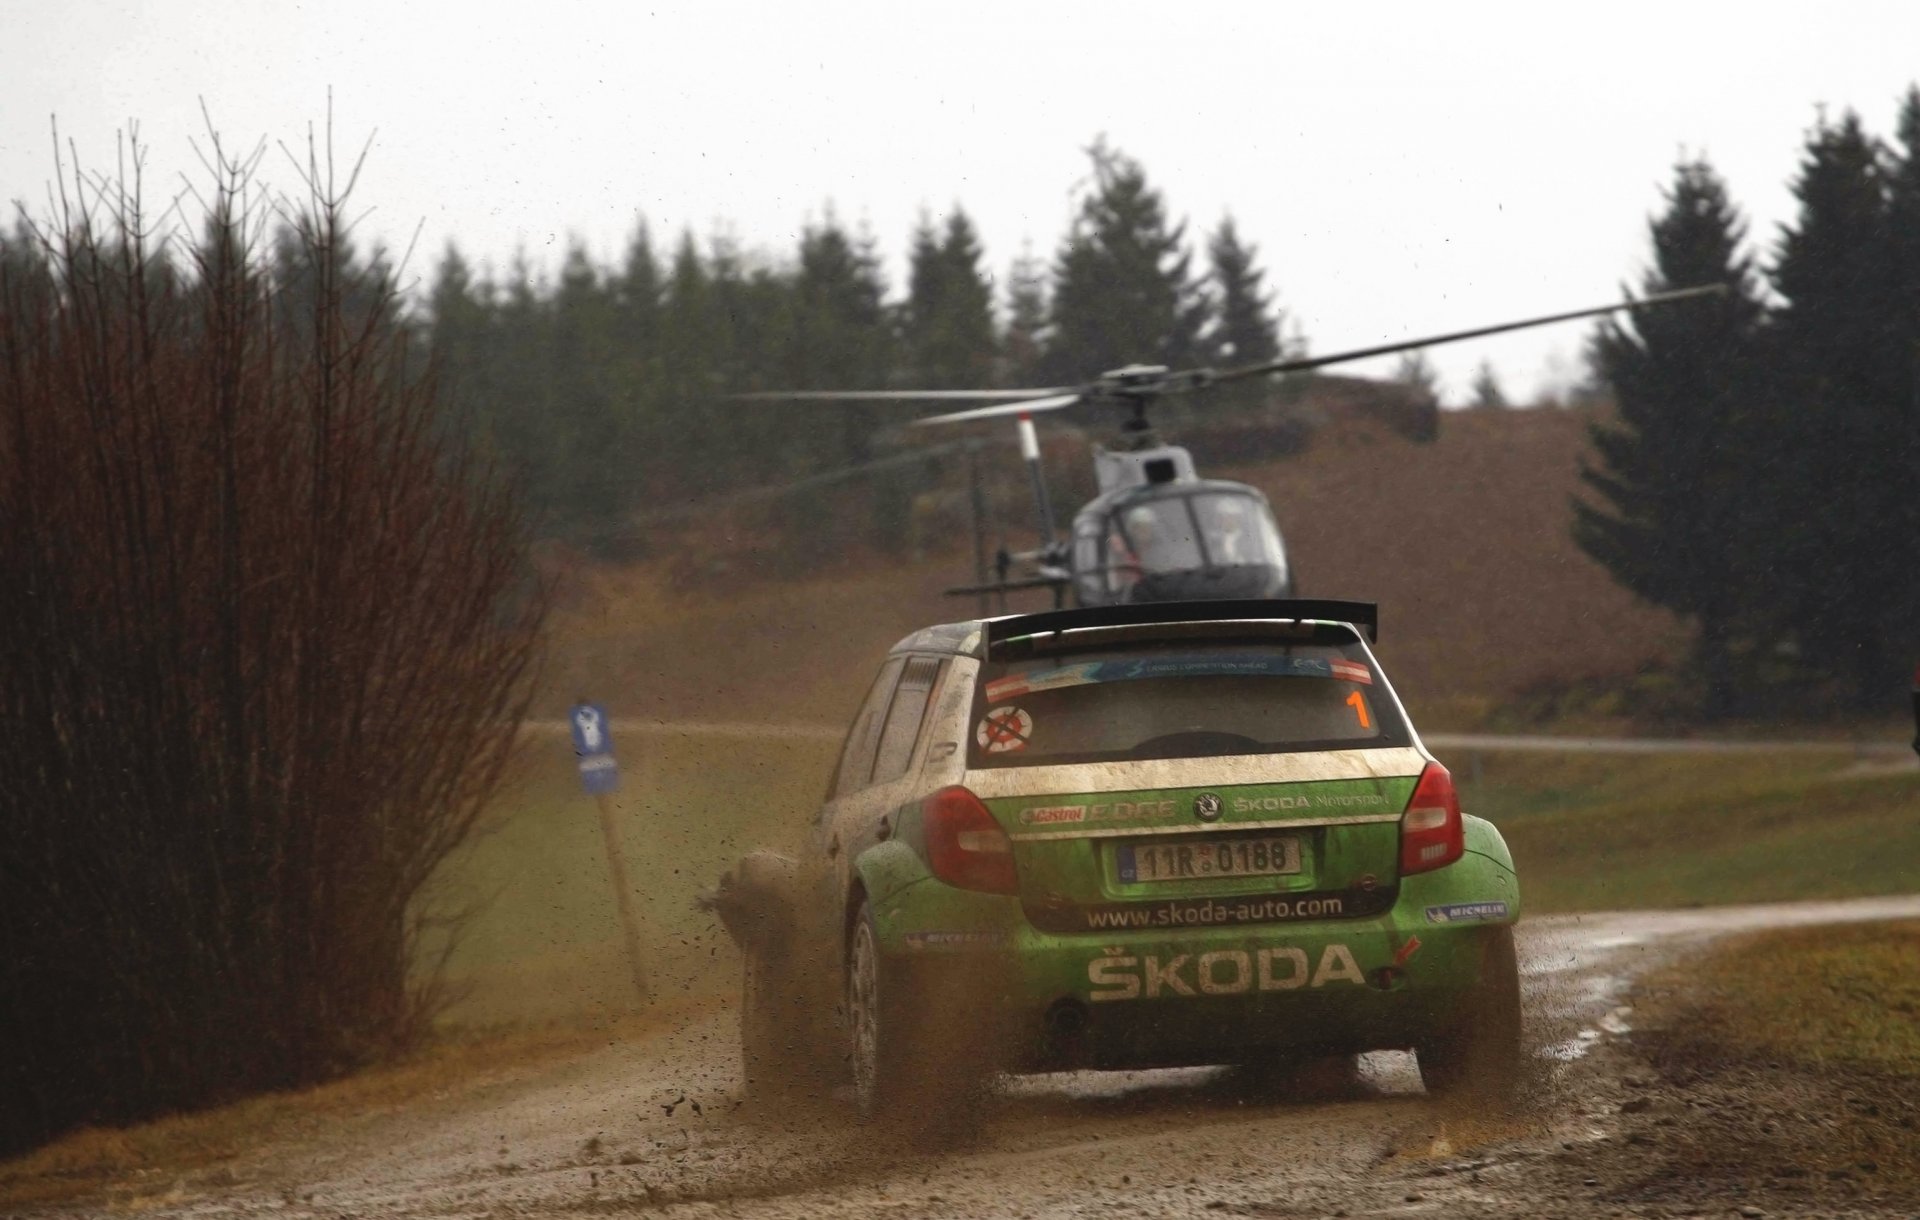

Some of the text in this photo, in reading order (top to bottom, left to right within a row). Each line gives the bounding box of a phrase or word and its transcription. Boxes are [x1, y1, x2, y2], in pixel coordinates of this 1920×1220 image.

[1346, 690, 1370, 729] 1
[1035, 800, 1177, 823] Castrol EDGE
[1143, 841, 1287, 877] 11R 0188
[1088, 898, 1343, 928] www.skoda-auto.com
[1449, 904, 1505, 917] MICHELIN
[1087, 943, 1367, 1001] ŠKODA
